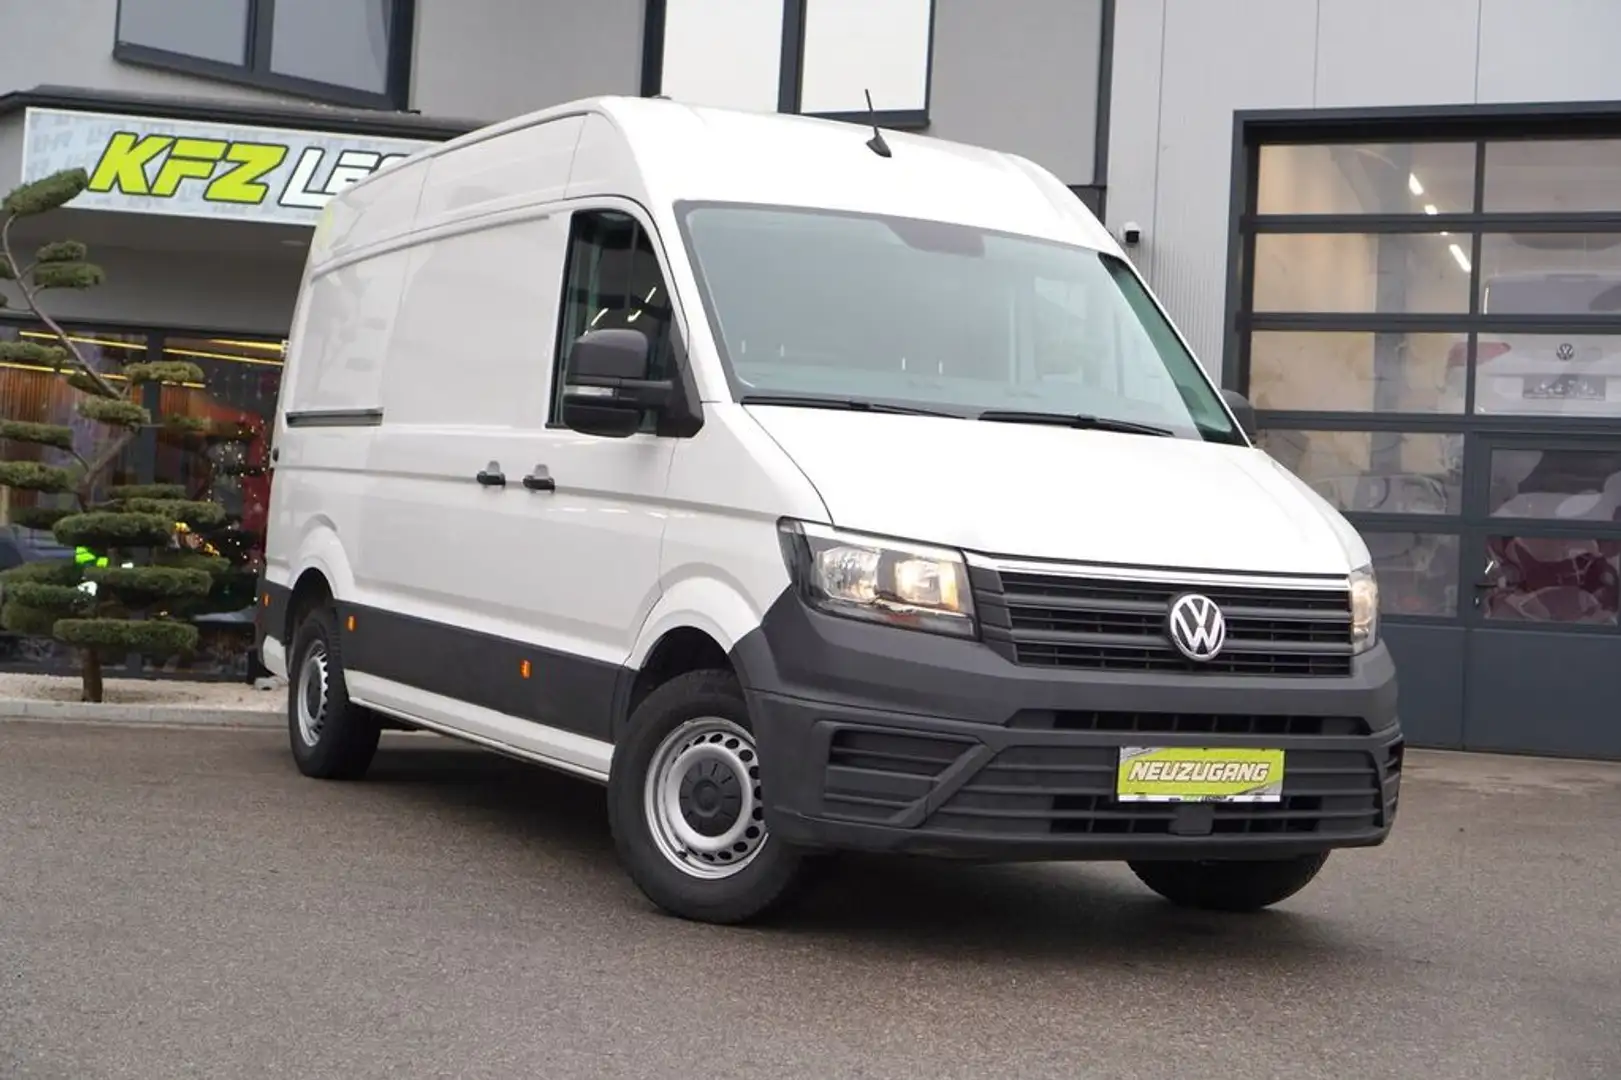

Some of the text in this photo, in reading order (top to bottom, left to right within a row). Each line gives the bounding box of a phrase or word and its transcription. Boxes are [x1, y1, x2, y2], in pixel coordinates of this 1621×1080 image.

[88, 131, 289, 204] KFZ
[1170, 594, 1226, 661] VW
[1128, 761, 1271, 782] NEUZUGANG
